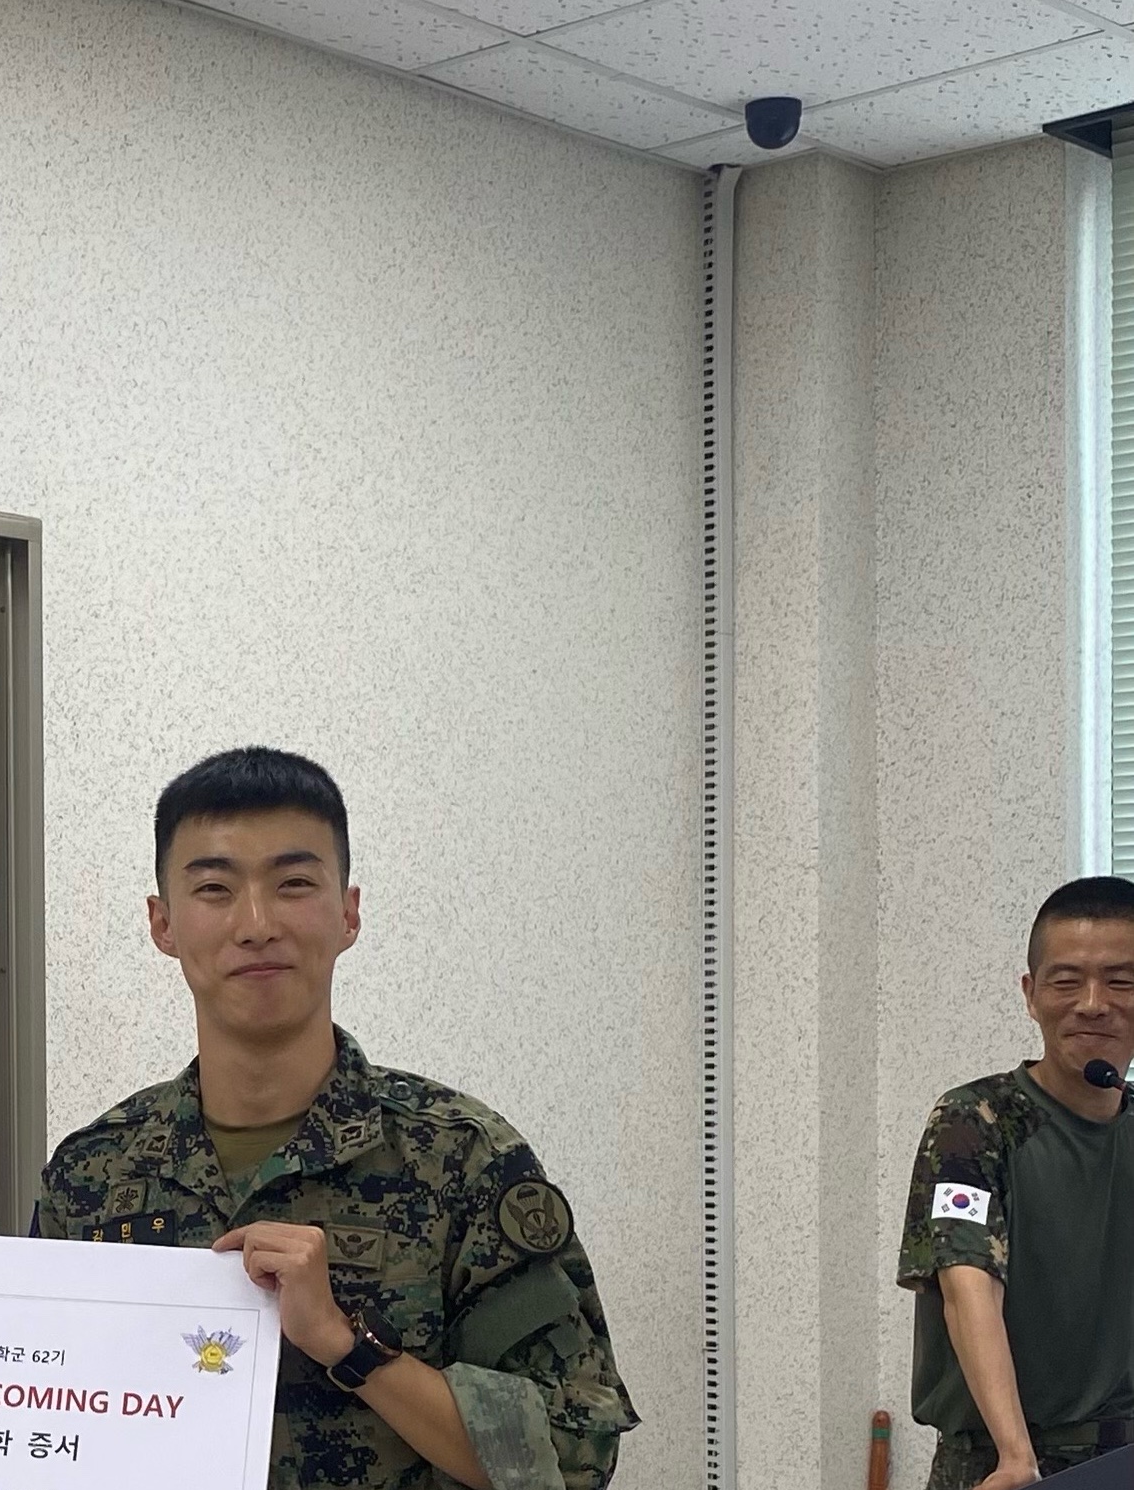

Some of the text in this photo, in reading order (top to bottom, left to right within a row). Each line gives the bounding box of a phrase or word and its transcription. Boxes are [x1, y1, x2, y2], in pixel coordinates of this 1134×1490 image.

[32, 1349, 66, 1367] 62기
[122, 1391, 185, 1419] DAY
[27, 1431, 80, 1462] 증서
